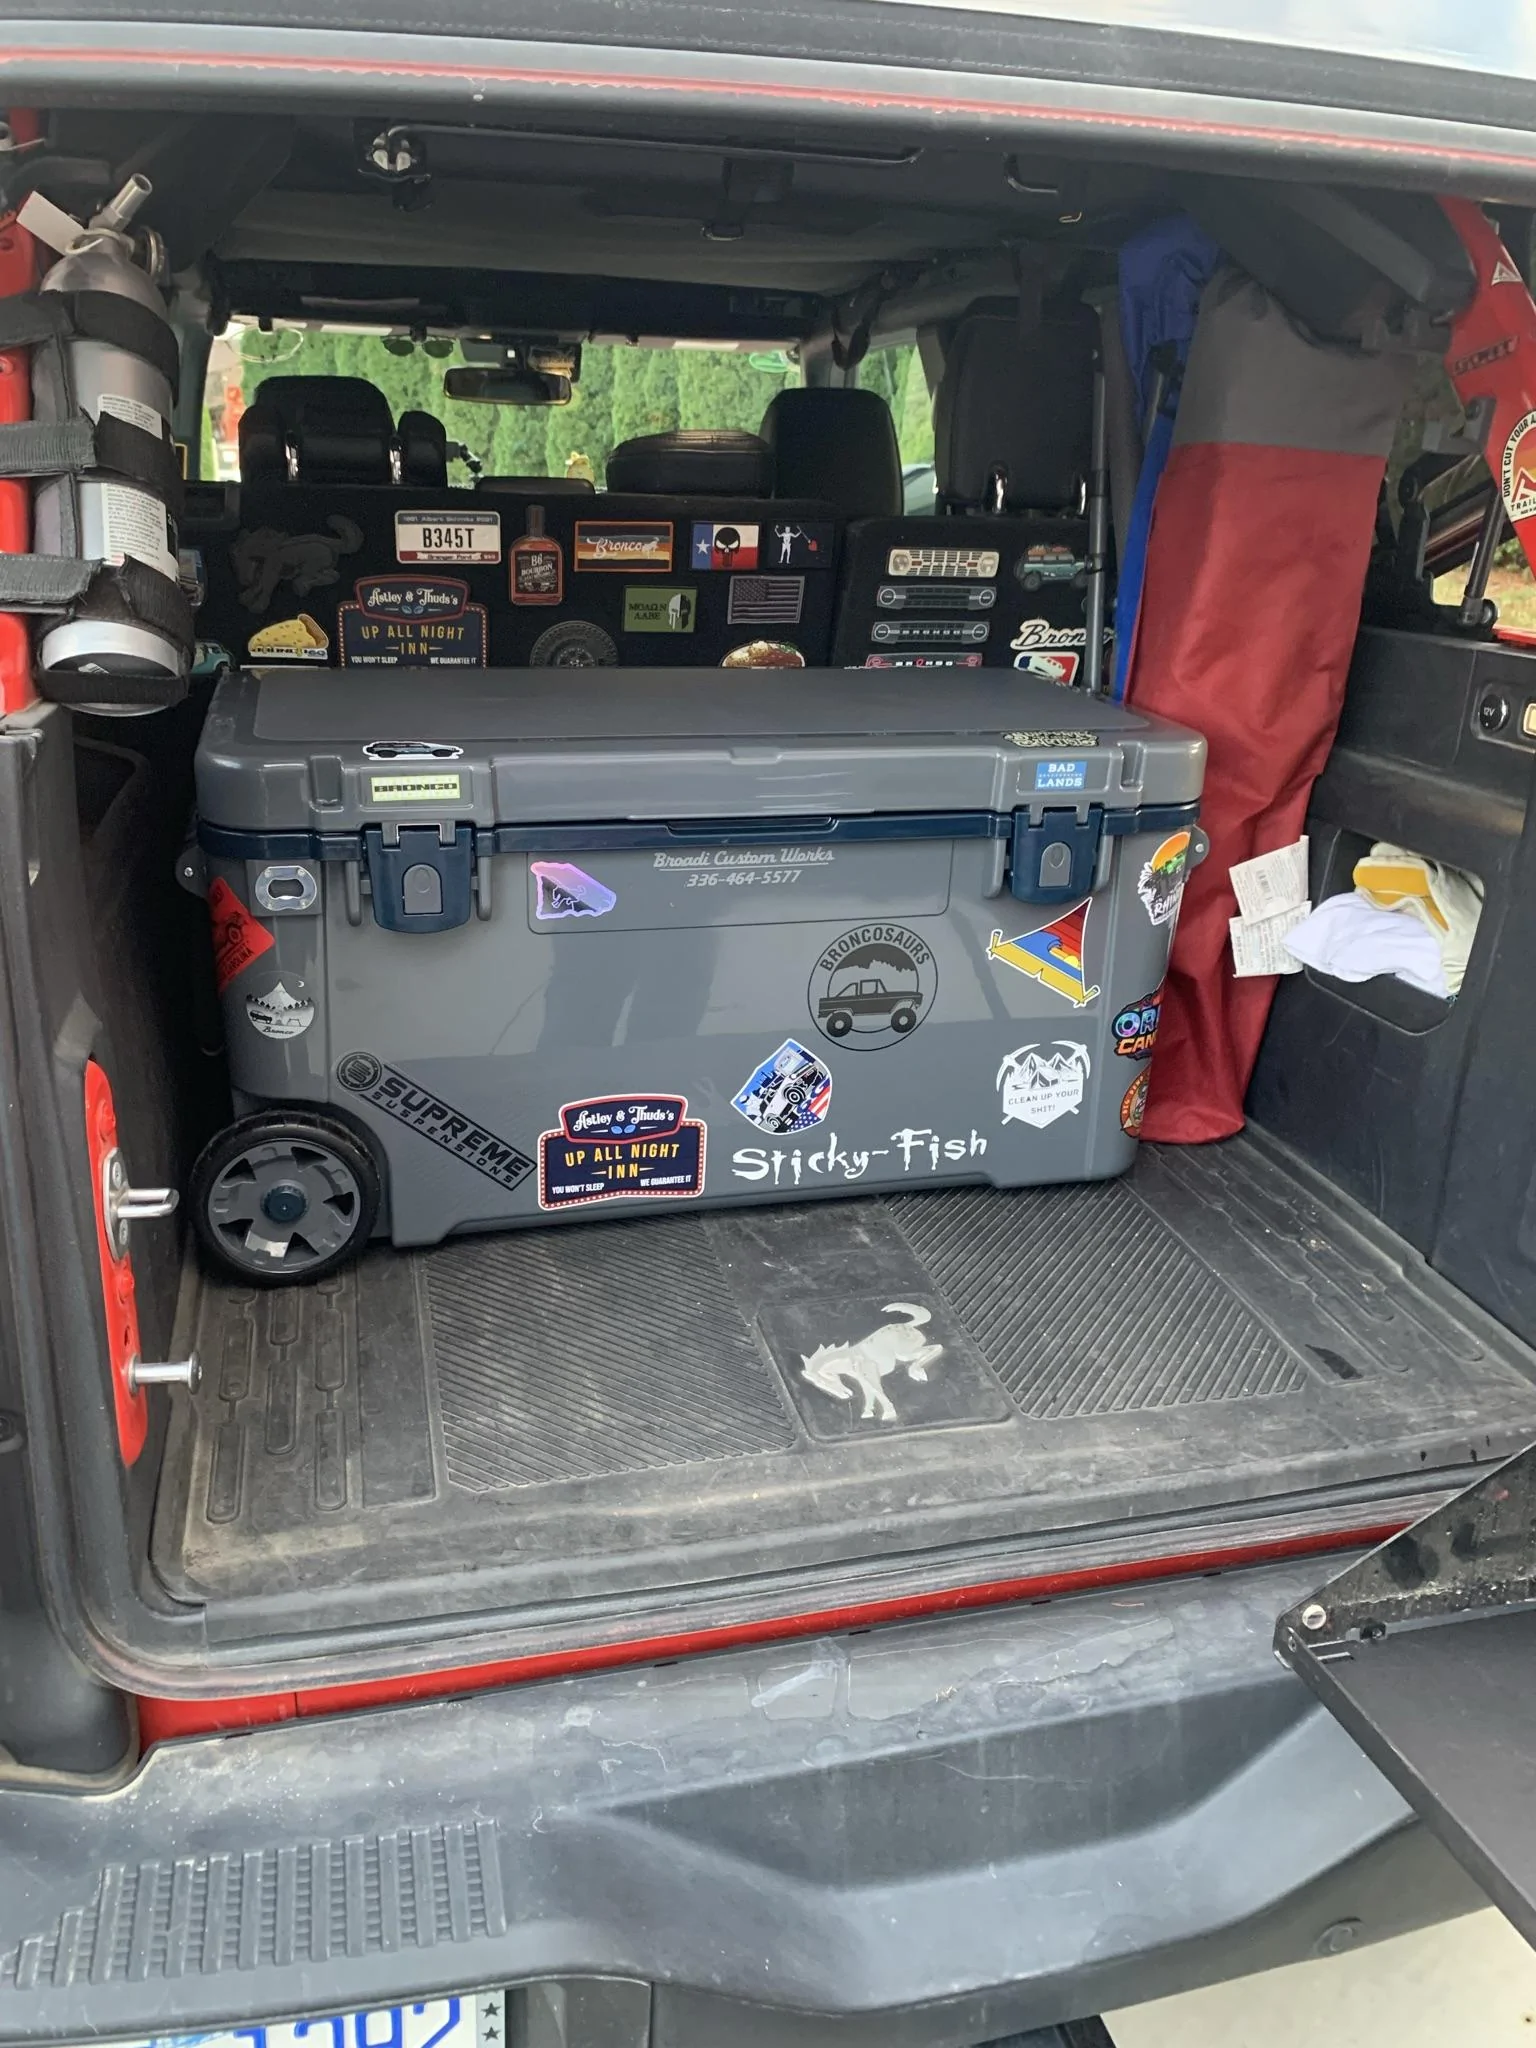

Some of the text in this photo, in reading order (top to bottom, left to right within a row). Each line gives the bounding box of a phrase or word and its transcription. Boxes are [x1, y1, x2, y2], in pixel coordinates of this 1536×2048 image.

[1510, 418, 1529, 443] YOUR
[1503, 447, 1514, 465] CUT
[1503, 470, 1511, 498] DON'T
[422, 528, 474, 548] B345T
[586, 537, 642, 559] Bronco
[521, 563, 553, 576] BOURBON
[367, 588, 458, 607] Astley & Thuds's
[361, 625, 464, 640] UP ALL NIGHT
[400, 642, 428, 655] INN
[351, 656, 398, 664] YOU WON'T SLEEP
[1047, 763, 1075, 773] BAD
[374, 783, 458, 792] BRONCO
[1037, 777, 1083, 788] LANDS
[653, 847, 835, 868] Broadi Custom Works
[819, 926, 930, 971] BRONCOSAURS
[263, 1026, 294, 1034] Bronco
[1008, 1095, 1038, 1105] CLEAN
[1056, 1089, 1079, 1098] YOUR
[1030, 1104, 1056, 1114] SHIT!
[573, 1105, 675, 1132] Astley & Thuds's
[378, 1077, 529, 1178] SUPREME
[371, 1091, 514, 1183] SUSPENSIONS
[564, 1143, 680, 1167] UP ALL NIGHT
[732, 1128, 988, 1185] Sticky-Fish
[608, 1163, 639, 1180] INN
[552, 1182, 605, 1195] YOU WON'T SLEEP
[640, 1174, 692, 1187] WE GUARANTEE IT
